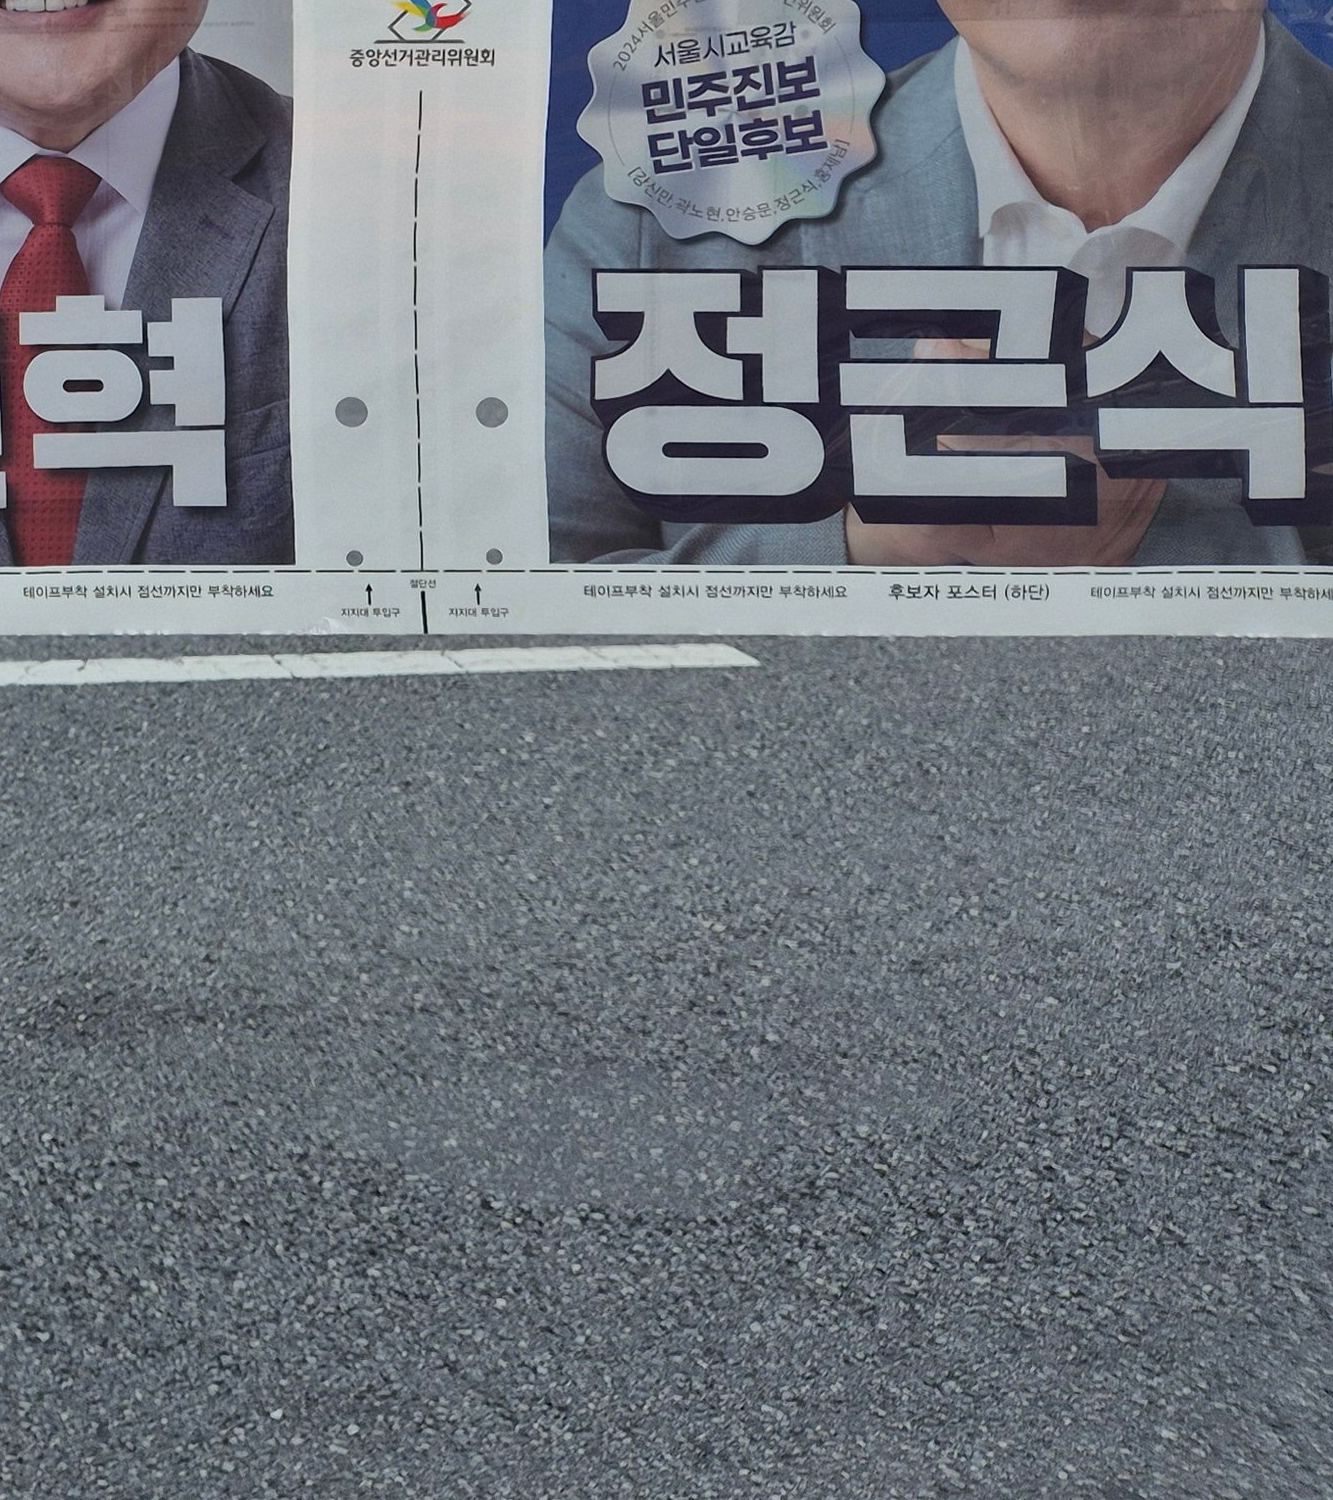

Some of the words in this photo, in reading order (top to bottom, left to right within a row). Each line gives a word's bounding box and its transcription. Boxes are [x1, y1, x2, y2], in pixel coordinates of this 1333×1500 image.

[350, 48, 495, 67] 중앙선거관리위원회
[654, 21, 797, 68] 서울시교육감
[641, 55, 820, 125] 민주진보
[647, 109, 828, 175] 단일후보
[593, 268, 1305, 500] 정근식
[23, 585, 87, 598] 테이프부착
[93, 586, 131, 598] 설치시
[138, 586, 201, 598] 점선까지만
[208, 585, 274, 598] 부착하세요
[584, 585, 652, 597] 테이프부착
[659, 585, 698, 598] 설치시
[706, 586, 773, 598] 점선까지만
[779, 586, 847, 598] 부착하세요
[889, 584, 939, 600] 후보자
[947, 585, 996, 600] 포스터
[1005, 585, 1049, 600] (하단)
